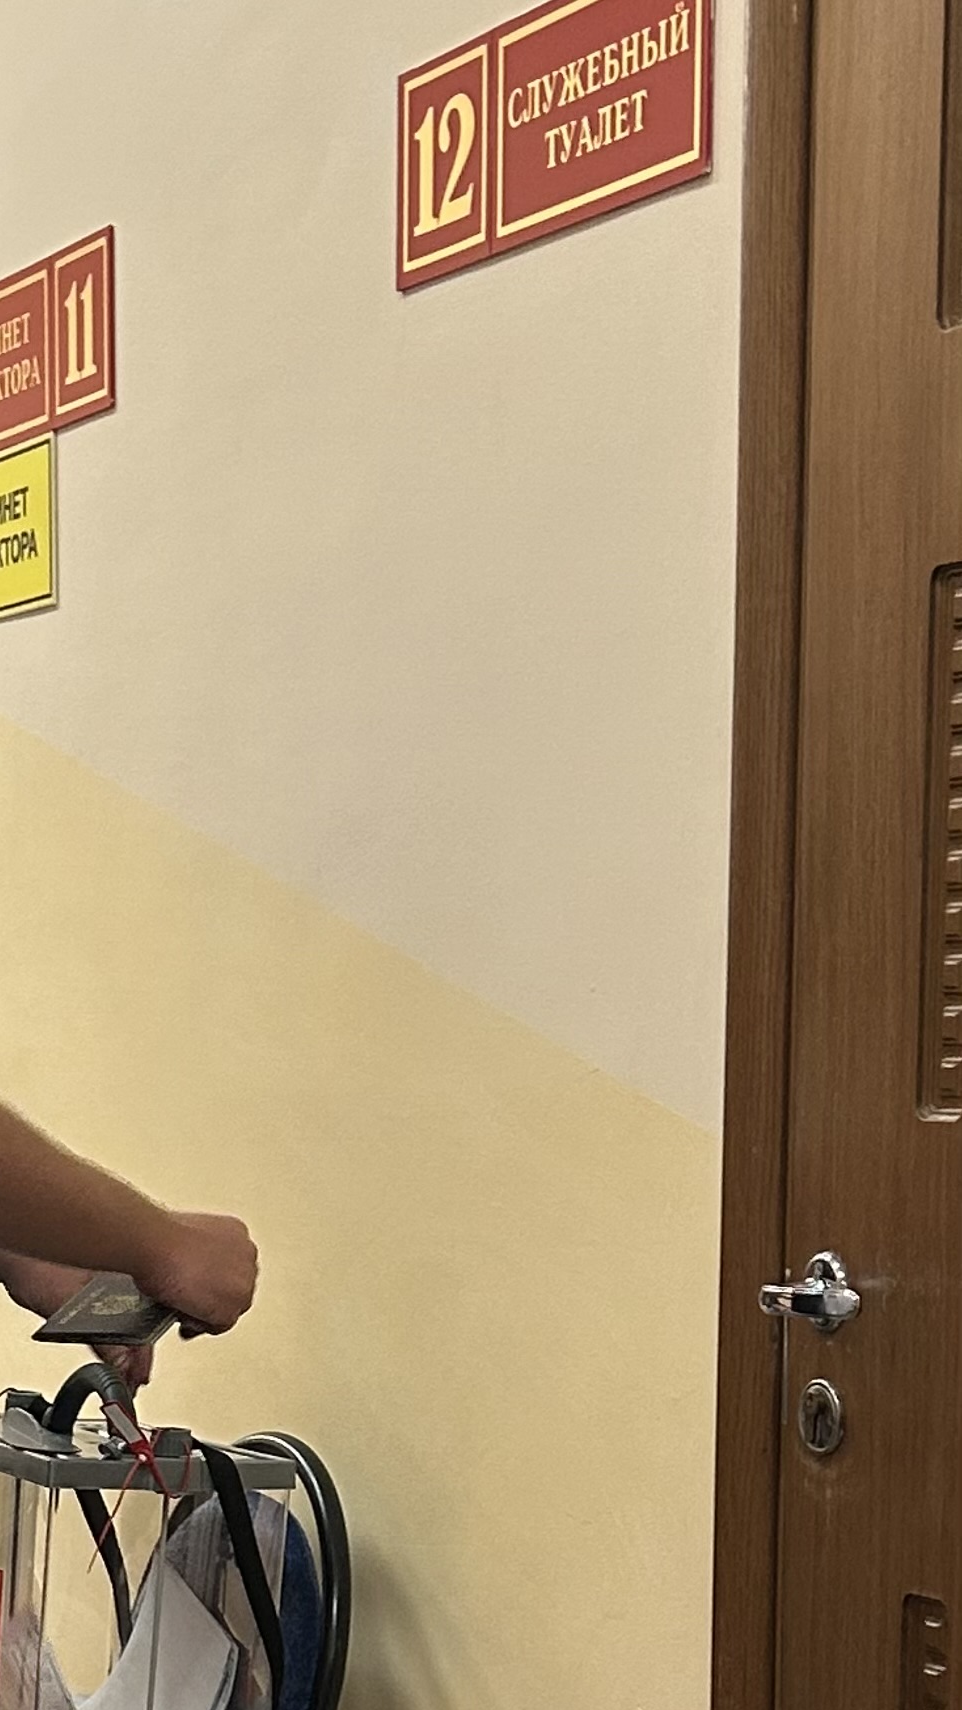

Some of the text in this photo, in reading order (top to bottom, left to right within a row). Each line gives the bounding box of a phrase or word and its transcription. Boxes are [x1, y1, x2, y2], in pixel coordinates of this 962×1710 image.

[507, 1, 690, 128] СЛУЖЕБНЫЙ
[413, 93, 475, 236] 12
[544, 90, 648, 168] ТУАЛЕТ
[64, 273, 97, 386] 11
